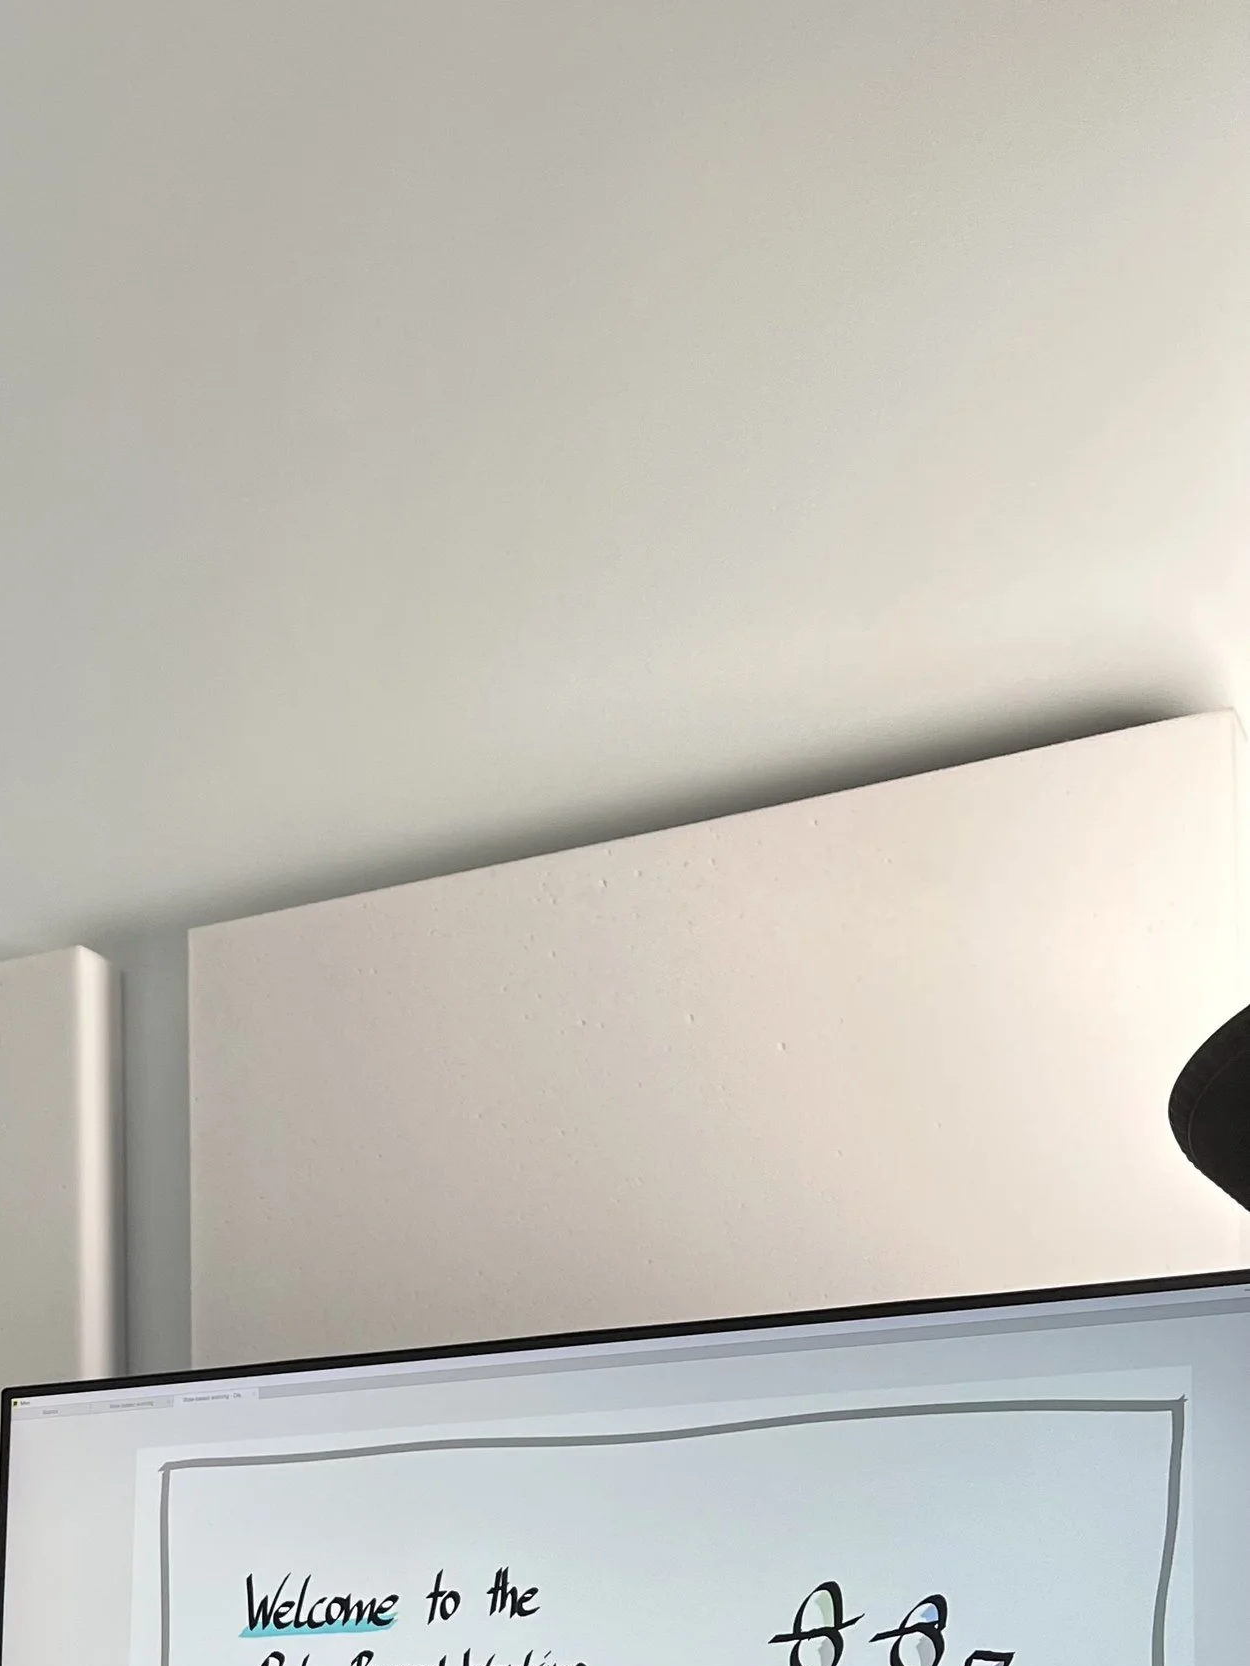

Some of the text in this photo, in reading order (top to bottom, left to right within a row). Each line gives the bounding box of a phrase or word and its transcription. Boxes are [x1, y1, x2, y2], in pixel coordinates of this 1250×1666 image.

[246, 1566, 540, 1630] Welcome to the
